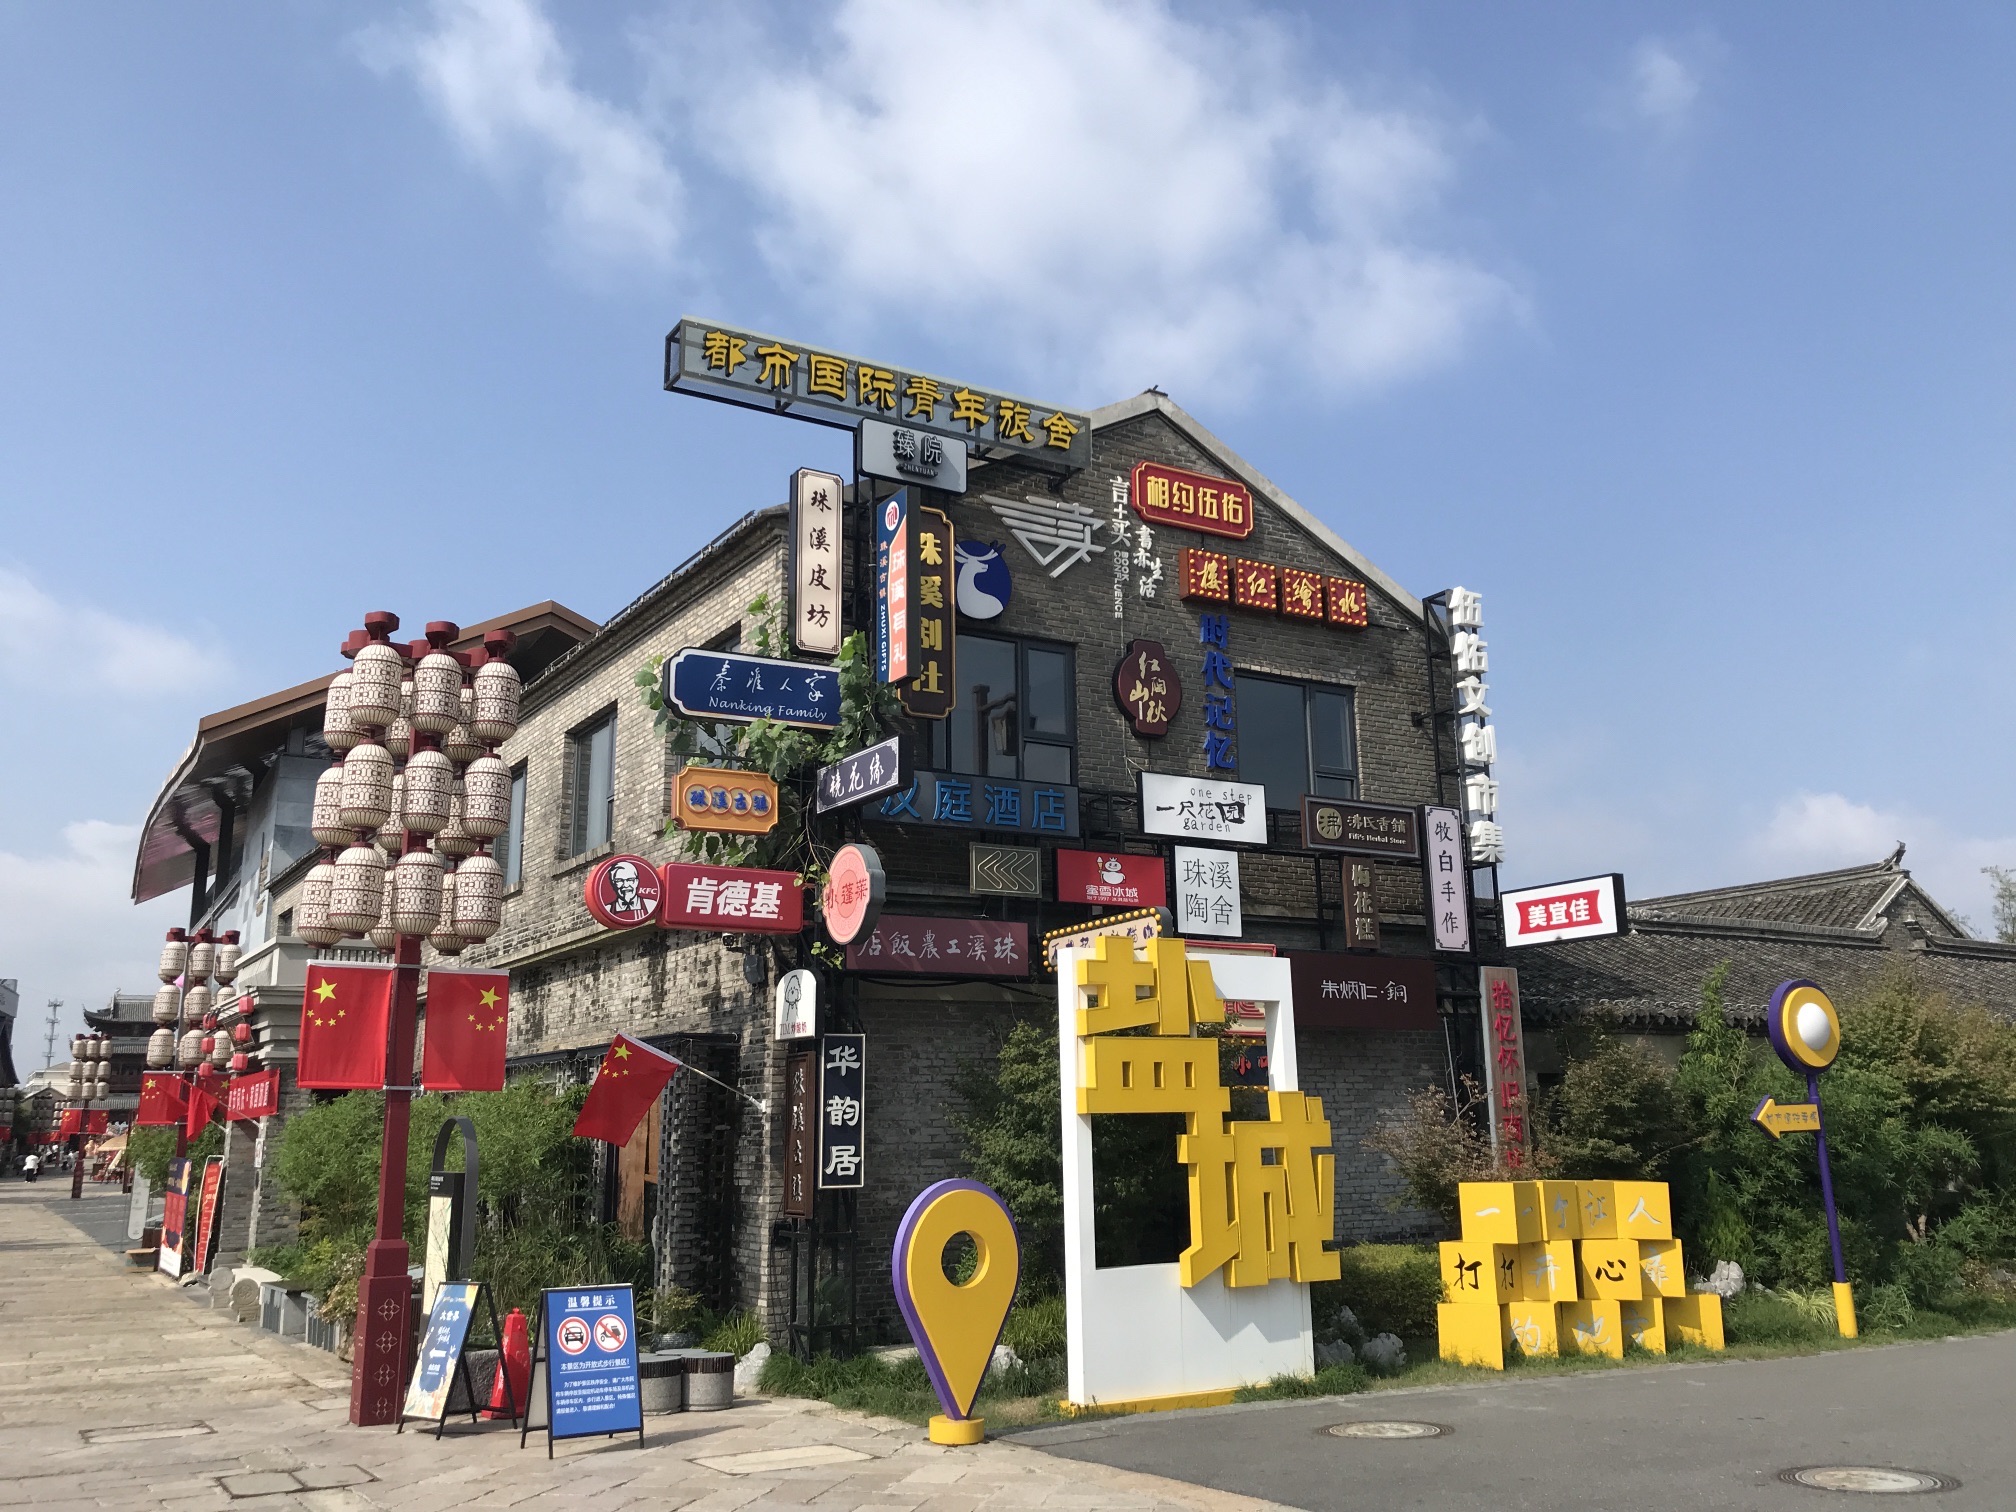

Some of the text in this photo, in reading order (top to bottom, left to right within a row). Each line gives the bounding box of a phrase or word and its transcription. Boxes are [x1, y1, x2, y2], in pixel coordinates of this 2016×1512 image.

[702, 330, 1079, 450] 都市国际青年旅舍
[895, 428, 943, 465] 臻院
[1146, 475, 1243, 525] 相约伍佑
[805, 488, 833, 629] 珠溪皮坊
[1121, 551, 1130, 581] BOOK
[1113, 551, 1123, 619] CONFLUENCE
[891, 548, 906, 665] 珠溪有礼
[708, 659, 828, 703] 秦淮人家
[1200, 613, 1236, 769] 时代记忆
[708, 696, 828, 722] Nanking Family
[1449, 585, 1506, 864] 伍佑文创市集
[829, 755, 886, 801] 镜花缘
[1190, 787, 1253, 806] one step
[880, 777, 1067, 832] 汉庭酒店
[1156, 801, 1247, 825] 一尺花园
[1183, 817, 1231, 833] garden
[1366, 834, 1388, 844] Herbal
[1389, 836, 1407, 846] Store
[638, 887, 659, 896] KFC
[1085, 884, 1139, 899] 蜜雪冰城
[1182, 858, 1233, 890] 珠溪
[1433, 820, 1460, 936] 牧白手作
[685, 877, 783, 921] 肯德基
[1185, 893, 1233, 926] 陶舍
[1527, 895, 1592, 930] 美宜佳
[823, 1045, 861, 1177] 华韵居
[566, 1293, 617, 1309] 温馨提示
